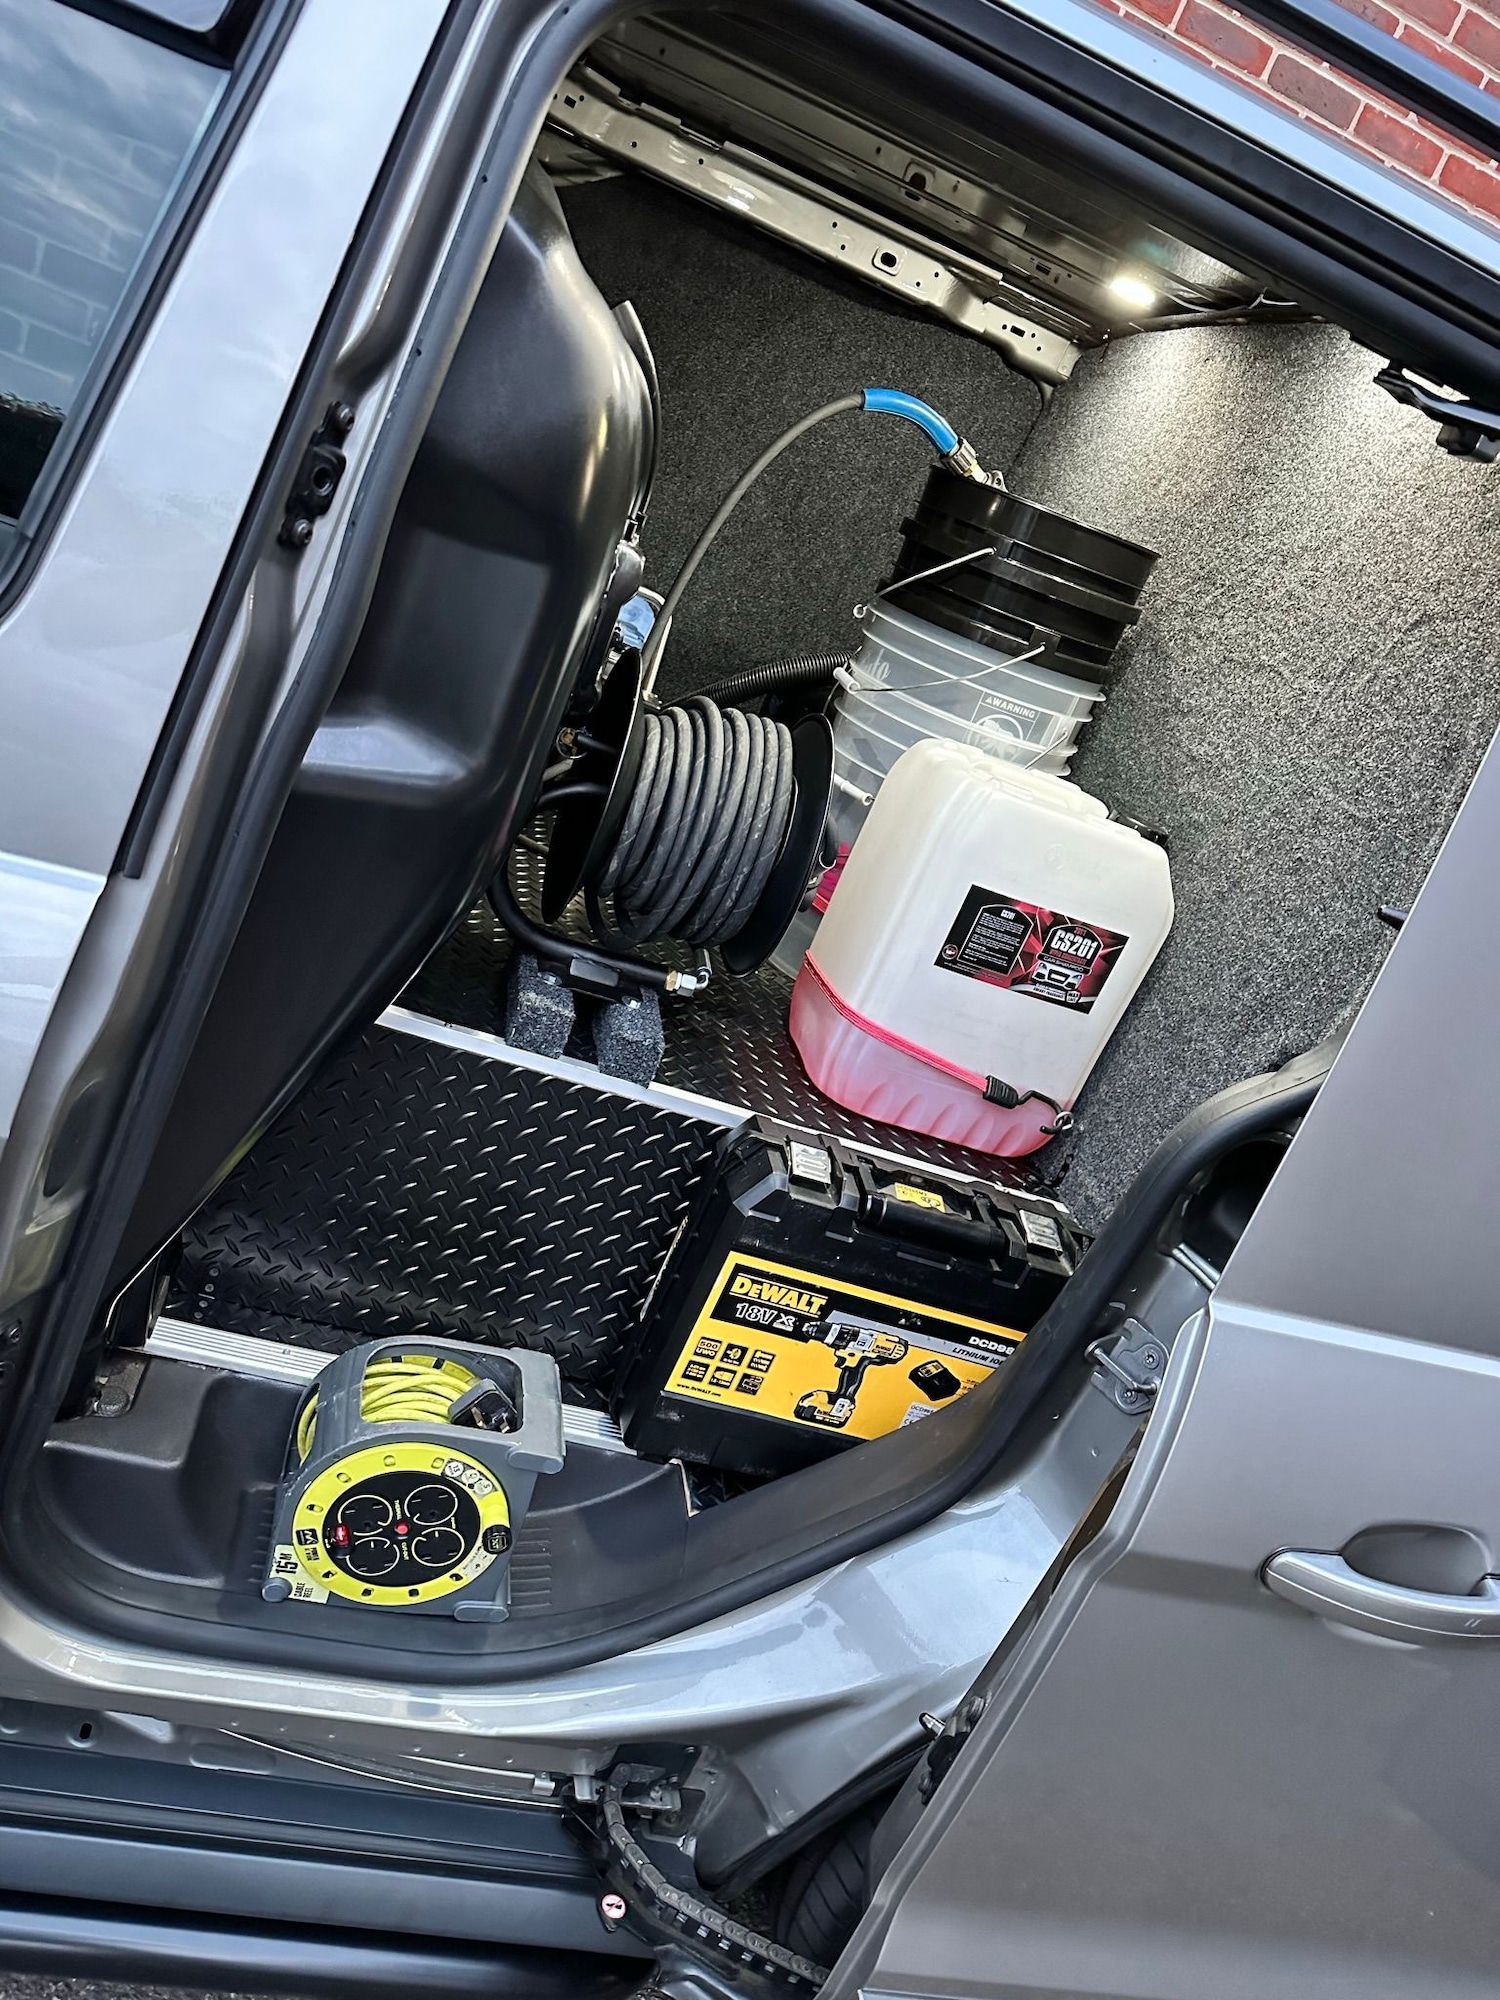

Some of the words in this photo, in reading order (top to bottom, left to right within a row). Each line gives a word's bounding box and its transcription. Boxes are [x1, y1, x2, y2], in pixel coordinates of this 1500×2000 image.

[992, 696, 1036, 720] WARNING
[1050, 929, 1099, 960] CS201
[735, 1303, 778, 1324] 18V
[695, 1347, 716, 1357] UWO
[699, 1341, 718, 1350] 500
[952, 1347, 989, 1362] LITHIUM
[294, 1582, 306, 1598] CABLE
[303, 1587, 314, 1598] REEL
